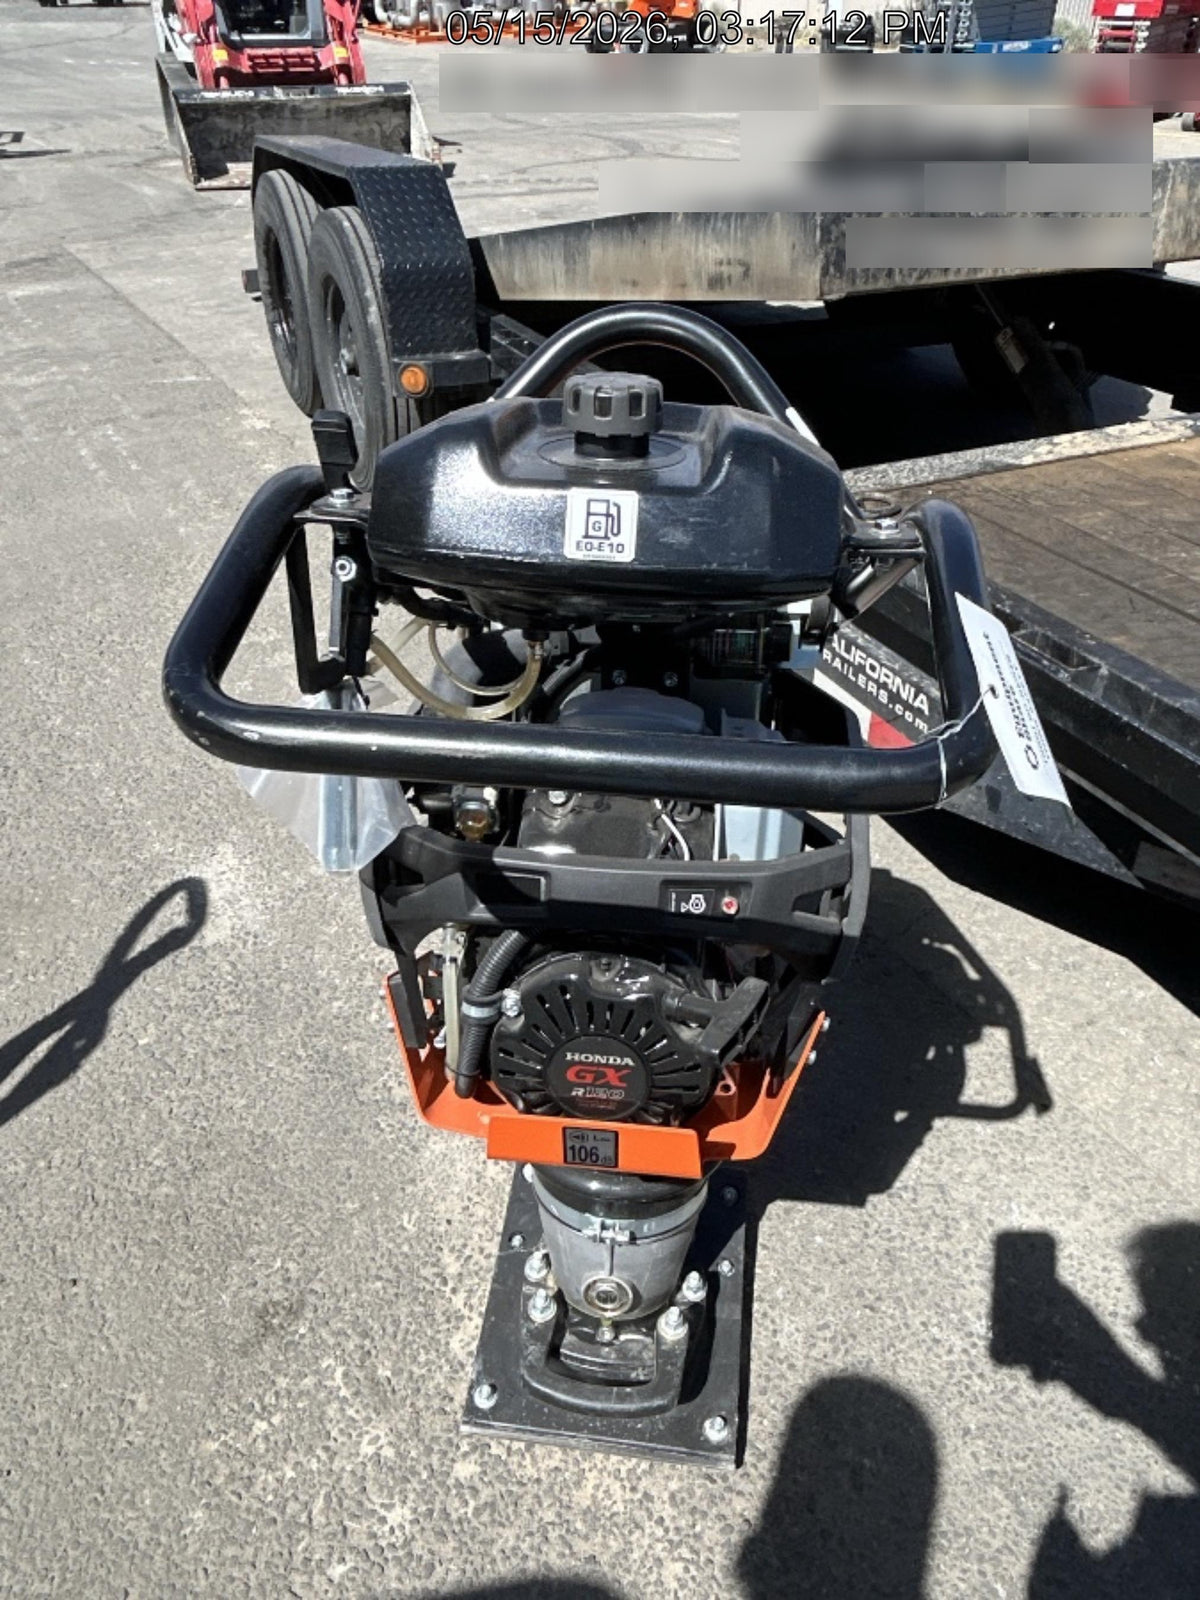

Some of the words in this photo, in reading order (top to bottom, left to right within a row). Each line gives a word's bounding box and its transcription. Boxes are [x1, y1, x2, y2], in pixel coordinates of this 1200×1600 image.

[832, 633, 929, 716] ALIFORNIA
[823, 649, 928, 734] RAILERS.com
[565, 1052, 635, 1066] HONDA
[565, 1064, 633, 1087] GX
[569, 1144, 600, 1164] 106
